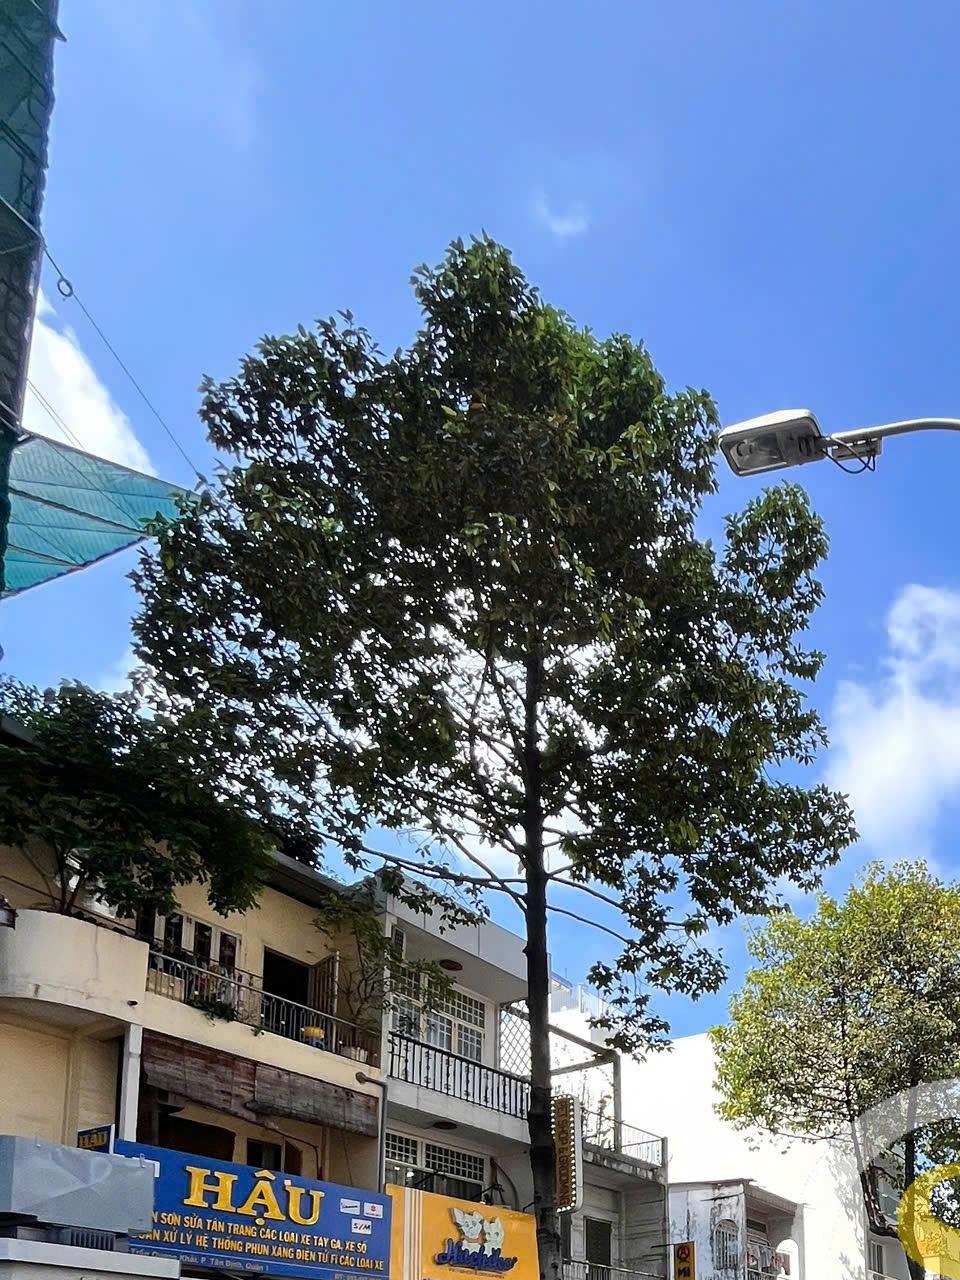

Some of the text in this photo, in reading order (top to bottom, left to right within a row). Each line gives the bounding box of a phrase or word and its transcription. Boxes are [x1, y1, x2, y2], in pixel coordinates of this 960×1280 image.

[183, 1165, 325, 1226] HẬU
[180, 1230, 193, 1245] LÝ
[212, 1234, 243, 1253] THỐNG
[245, 1242, 269, 1256] PHUN
[375, 1260, 384, 1271] XE
[184, 1212, 203, 1229] SỬA
[227, 1222, 257, 1237] TRANG
[300, 1234, 312, 1246] XE
[313, 1235, 329, 1249] TAY
[345, 1241, 355, 1252] XE
